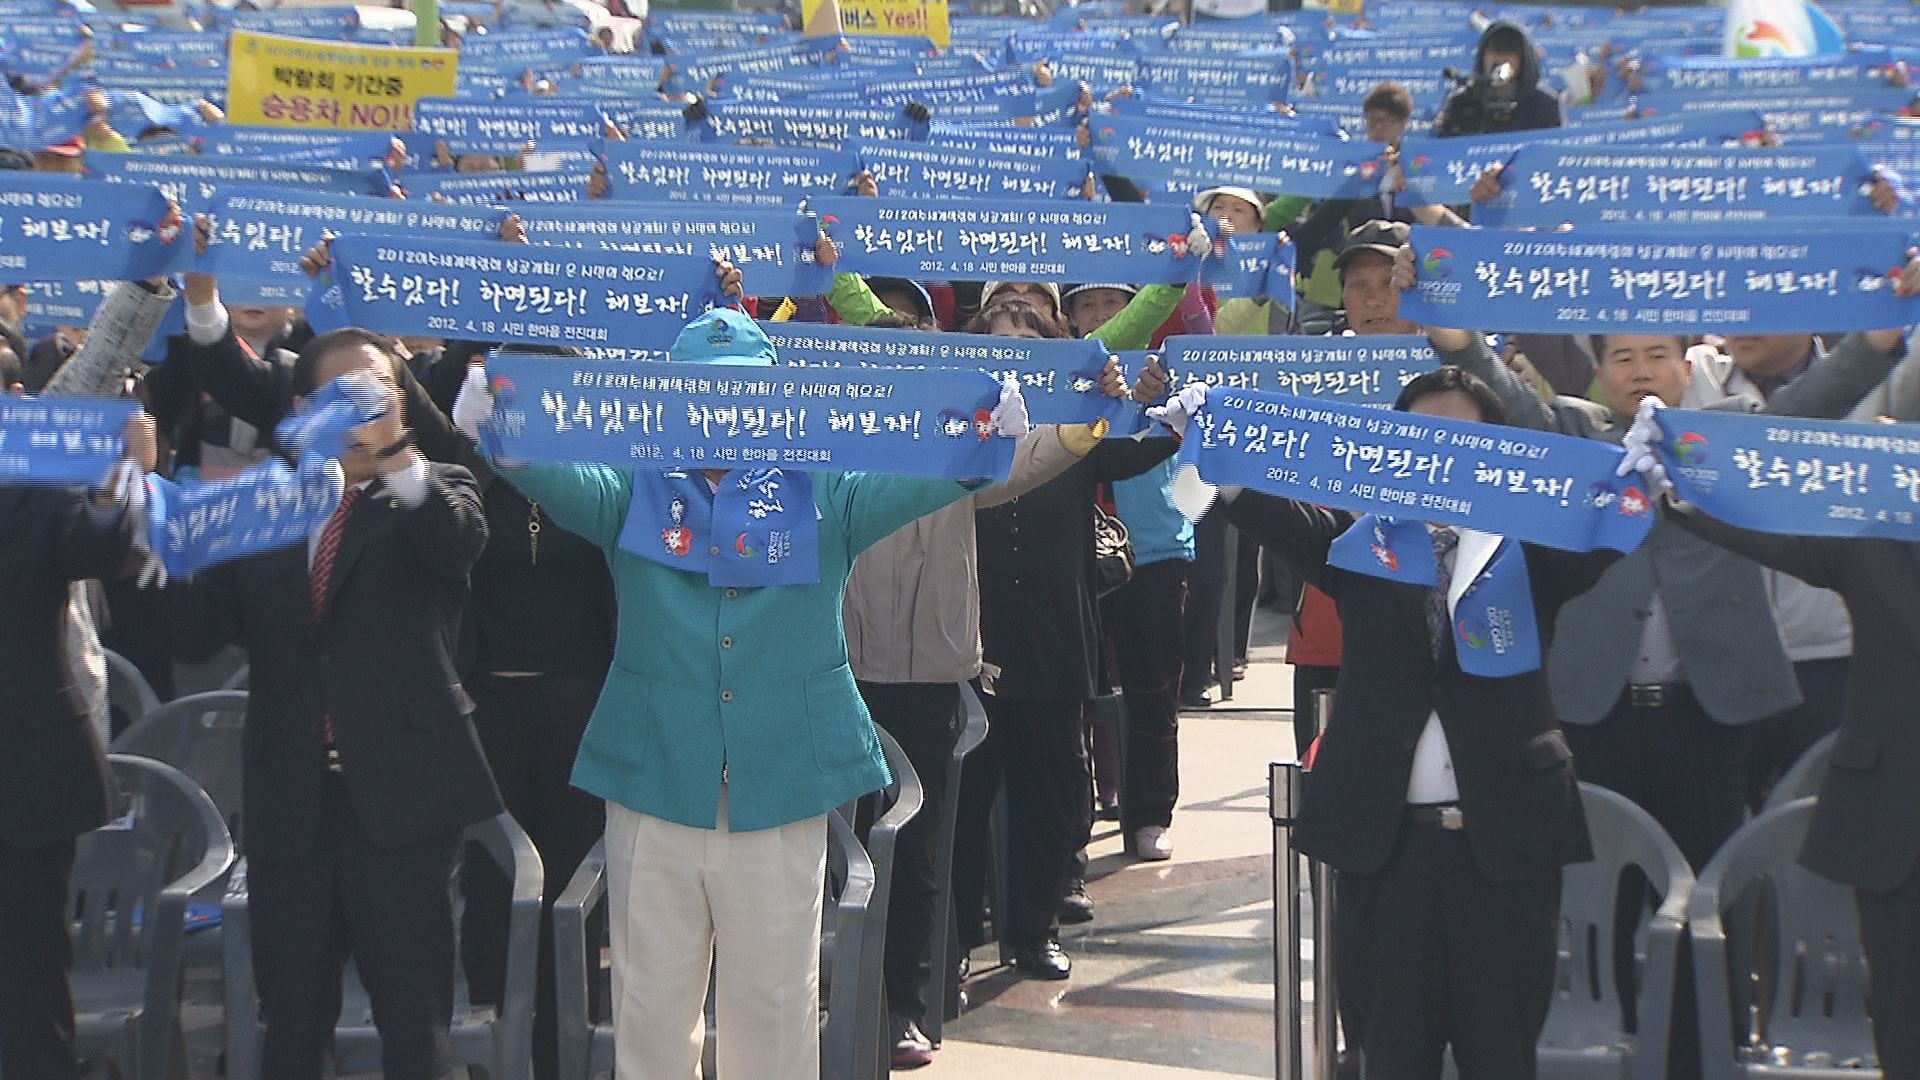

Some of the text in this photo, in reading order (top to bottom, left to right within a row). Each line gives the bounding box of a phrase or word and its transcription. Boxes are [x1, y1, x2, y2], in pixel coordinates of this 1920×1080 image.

[883, 8, 928, 30] Yes!!
[273, 66, 403, 97] 박람회 기간중
[262, 94, 342, 126] 승용차
[351, 103, 412, 130] NO!!
[708, 116, 773, 139] 할수있다!
[784, 120, 848, 140] 하면된다!
[1128, 136, 1193, 163] 할수있다!
[1206, 146, 1271, 171] 하면된다!
[1282, 155, 1333, 176] 해보자!
[619, 161, 689, 186] 할수있다!
[702, 167, 771, 190] 하면된다!
[783, 171, 837, 190] 해보자!
[922, 166, 990, 192] 하면된다!
[1002, 176, 1055, 197] 해보자!
[1530, 172, 1630, 203] 할수있다!
[1647, 175, 1747, 203] 하면된다!
[1762, 176, 1842, 199] 해보자!
[22, 216, 110, 246] 해보자!
[407, 213, 418, 227] 온
[879, 209, 1106, 225] 2012여수세계박람회 성공개최! 온 시민의 힘으로!
[855, 224, 1131, 255] 할수있다! 하면된다! 해보자!
[377, 248, 664, 281] 2012여수세계박람회 성공개최! 온 시민의 힘으로!
[920, 261, 1065, 274] 2012. 4. 18 시민 한마음 전진대회
[351, 265, 688, 318] 할수있다! 하면된다! 해보자!
[1475, 261, 1590, 299] 할수있다!
[1610, 267, 1726, 299] 하면된다!
[1745, 269, 1838, 295] 해보자!
[428, 316, 607, 341] 2012. 4. 18 시민 한마음 전진대회
[1556, 307, 1590, 321] 2012.
[1597, 309, 1609, 321] 4.
[1613, 309, 1629, 321] 18
[1635, 309, 1660, 323] 시민
[885, 342, 935, 356] 성공개최!
[940, 345, 950, 357] 온
[954, 347, 987, 358] 시민의
[992, 347, 1030, 360] 힘으로!
[1183, 350, 1297, 363] 2012여수세계박람회
[1301, 349, 1352, 363] 성공개최!
[1357, 349, 1367, 362] 온
[1372, 349, 1407, 361] 시민의
[717, 381, 776, 395] 성공개최!
[783, 383, 794, 397] 온
[801, 383, 840, 397] 시민의
[848, 383, 892, 397] 힘으로!
[1278, 370, 1380, 397] 하면된다!
[541, 391, 921, 438] 할수있다! 하면된다! 해보자!
[1224, 396, 1549, 458] 2012여수세계박람회 성공개최! 온 시민의 힘으로!
[630, 443, 831, 462] 2012. 4. 18 시민 한마음 전진대회
[1193, 410, 1573, 506] 할수있다! 하면된다! 해보자!
[1732, 448, 1869, 495] 할수있다!
[1267, 468, 1472, 514] 2012. 4. 18 시민 한마음 전진대회
